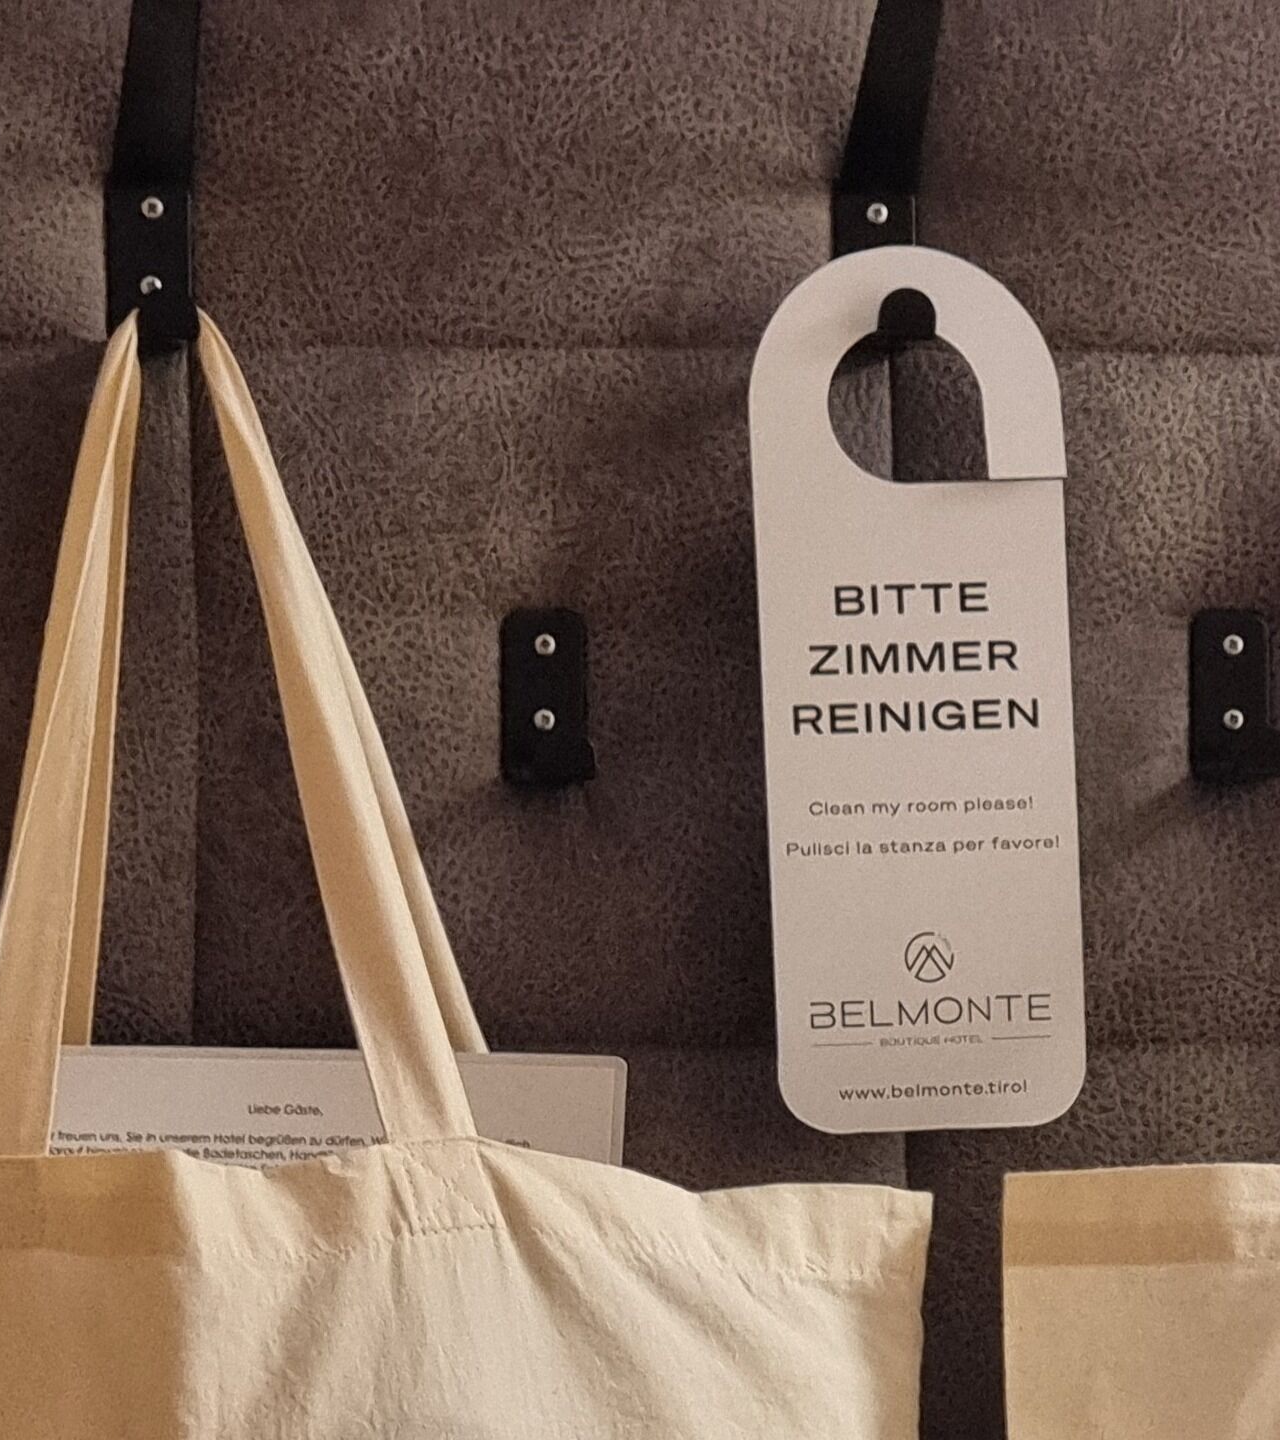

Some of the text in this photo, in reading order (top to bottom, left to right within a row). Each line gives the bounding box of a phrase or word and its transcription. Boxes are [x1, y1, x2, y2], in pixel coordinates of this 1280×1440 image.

[833, 581, 989, 616] BITTE
[809, 640, 1019, 676] ZIMMER
[792, 697, 1040, 735] REINIGEN
[808, 795, 1034, 817] Clean my room please!
[786, 835, 1061, 857] Pulisci la stanza per favore!
[809, 993, 1053, 1030] BELMONTE
[879, 1034, 984, 1047] BOUTIQUE HOTEL
[839, 1079, 1028, 1101] www.belmonte.tirol
[248, 1104, 281, 1115] Liebe
[126, 1131, 143, 1142] Sie
[213, 1133, 245, 1144] Hotel
